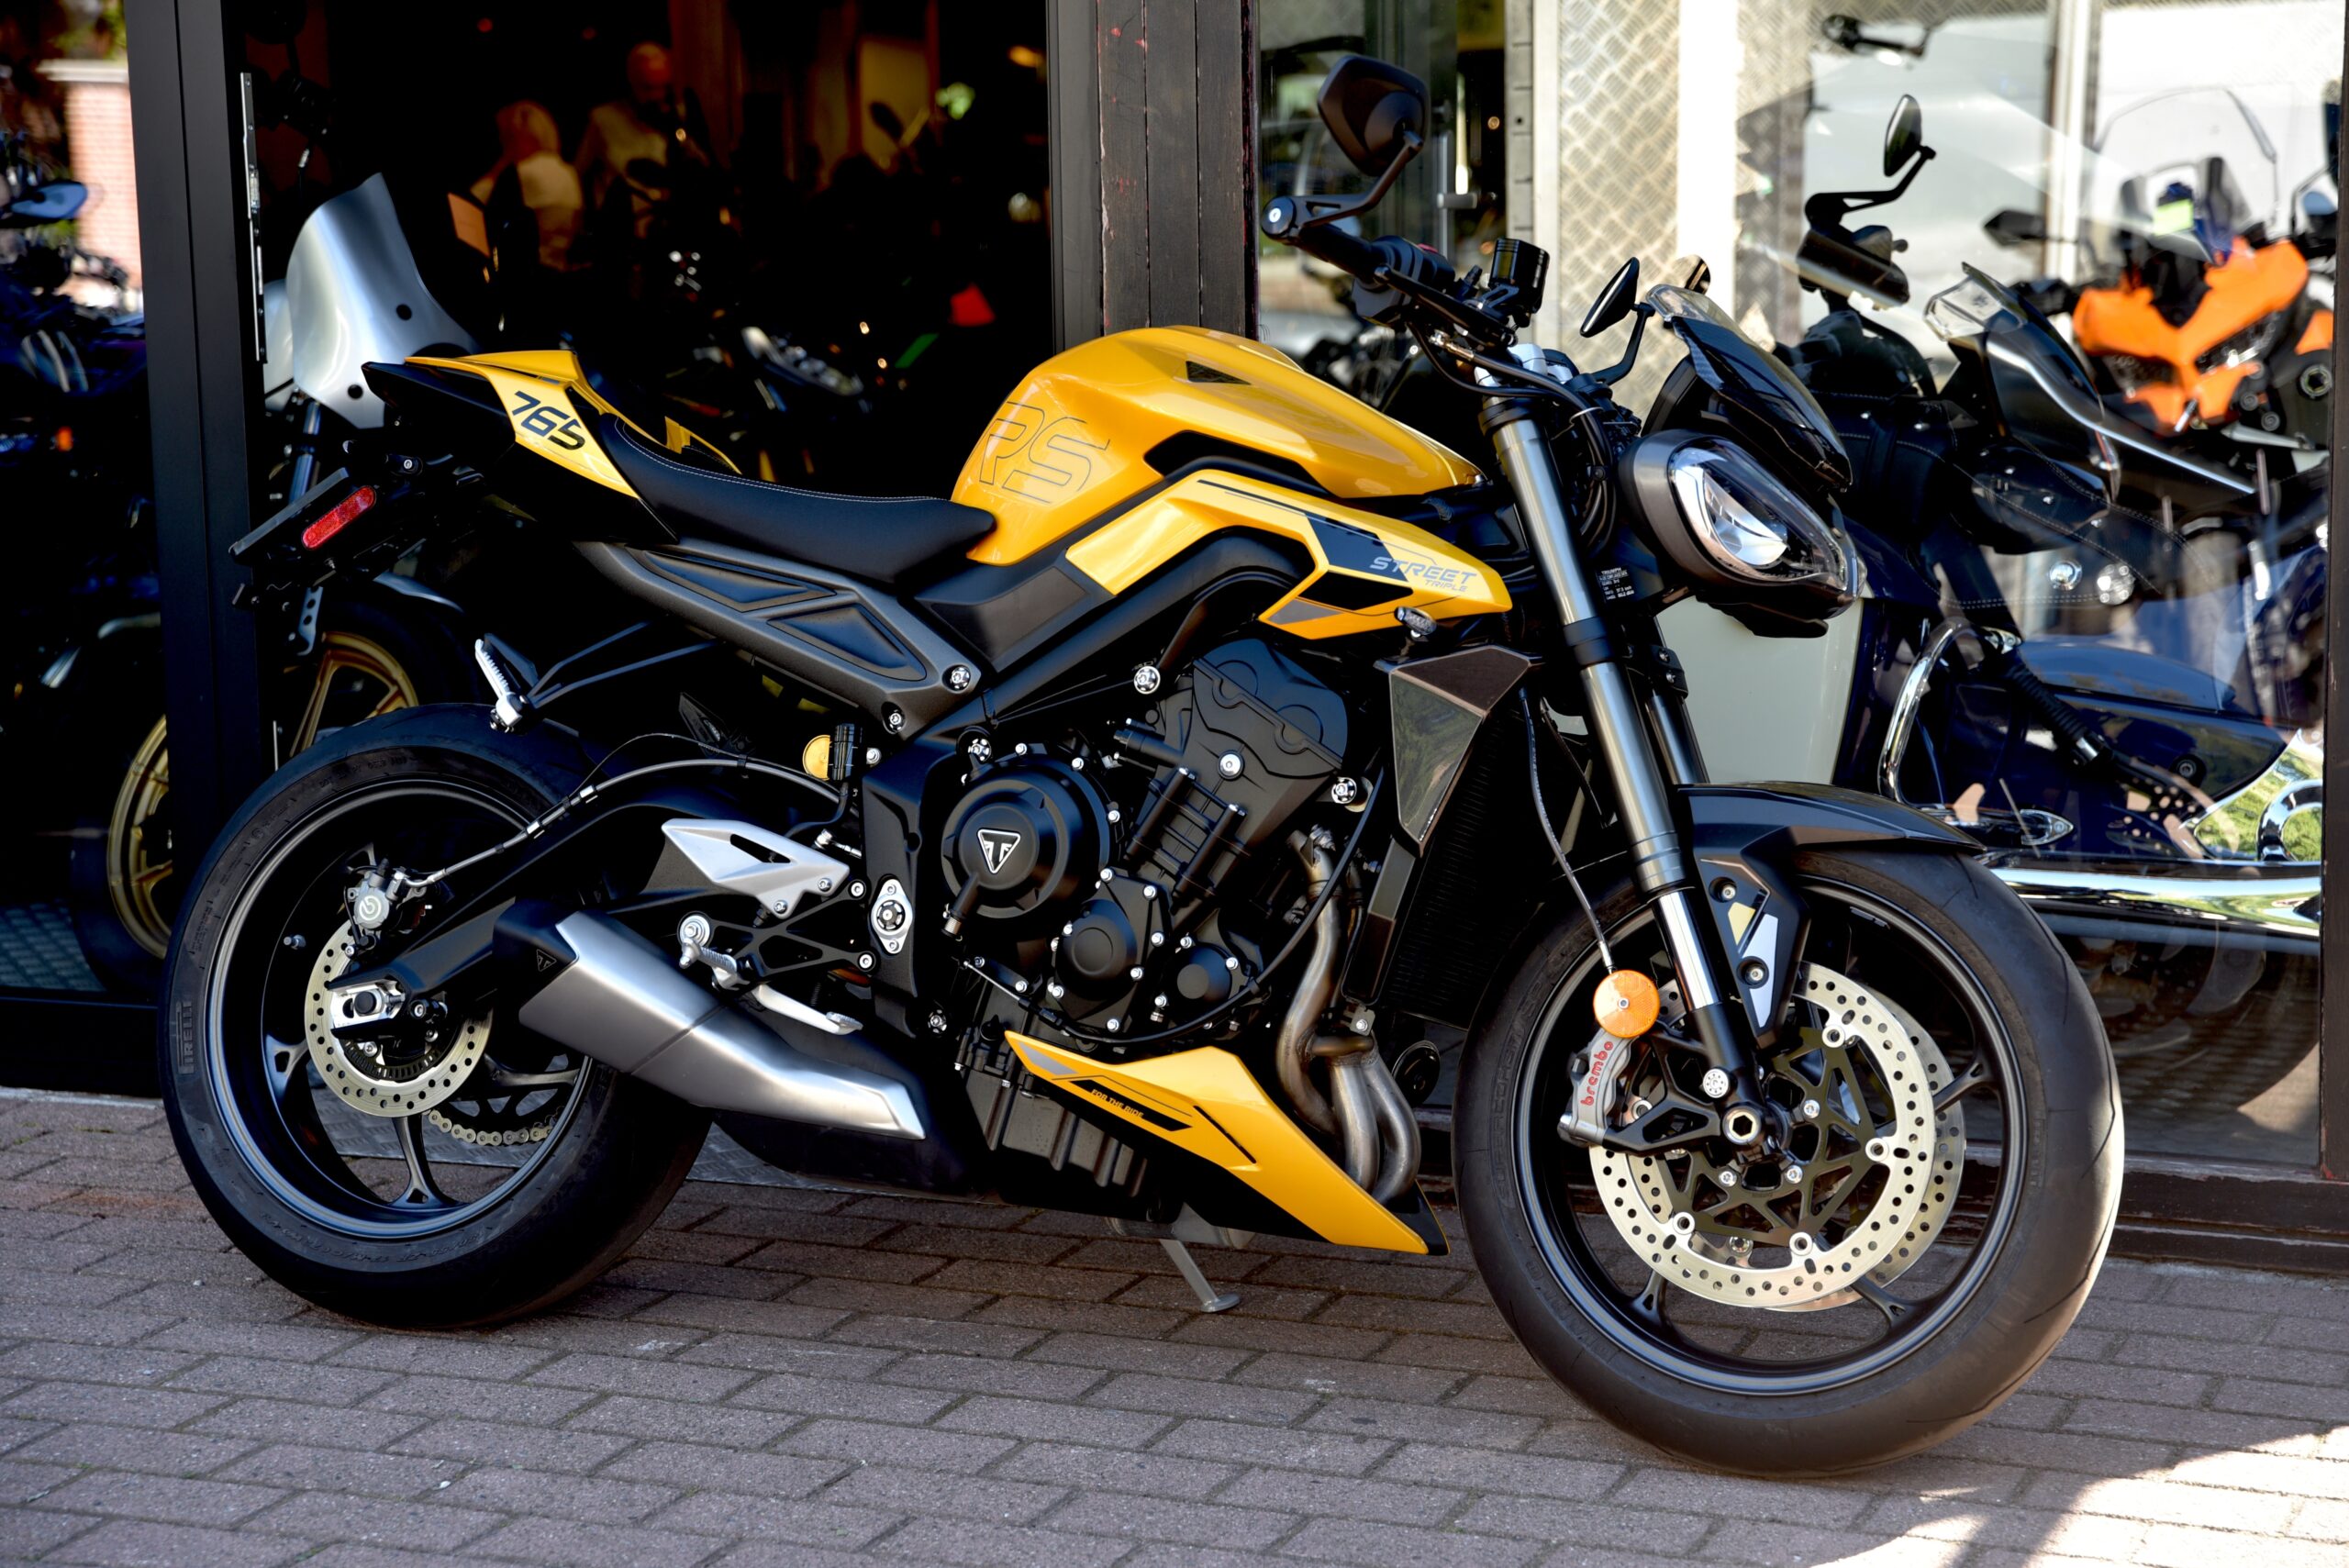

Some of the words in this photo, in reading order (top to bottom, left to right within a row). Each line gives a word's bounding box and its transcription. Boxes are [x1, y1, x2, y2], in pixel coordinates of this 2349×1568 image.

[511, 390, 585, 450] 765
[1370, 556, 1477, 584] STREET
[1425, 579, 1468, 593] TRIPLE
[175, 1000, 195, 1075] PIRELLI
[1580, 1040, 1614, 1106] brembo
[1092, 1088, 1108, 1101] FOR
[1108, 1096, 1125, 1109] THE
[1124, 1105, 1144, 1118] RIDE
